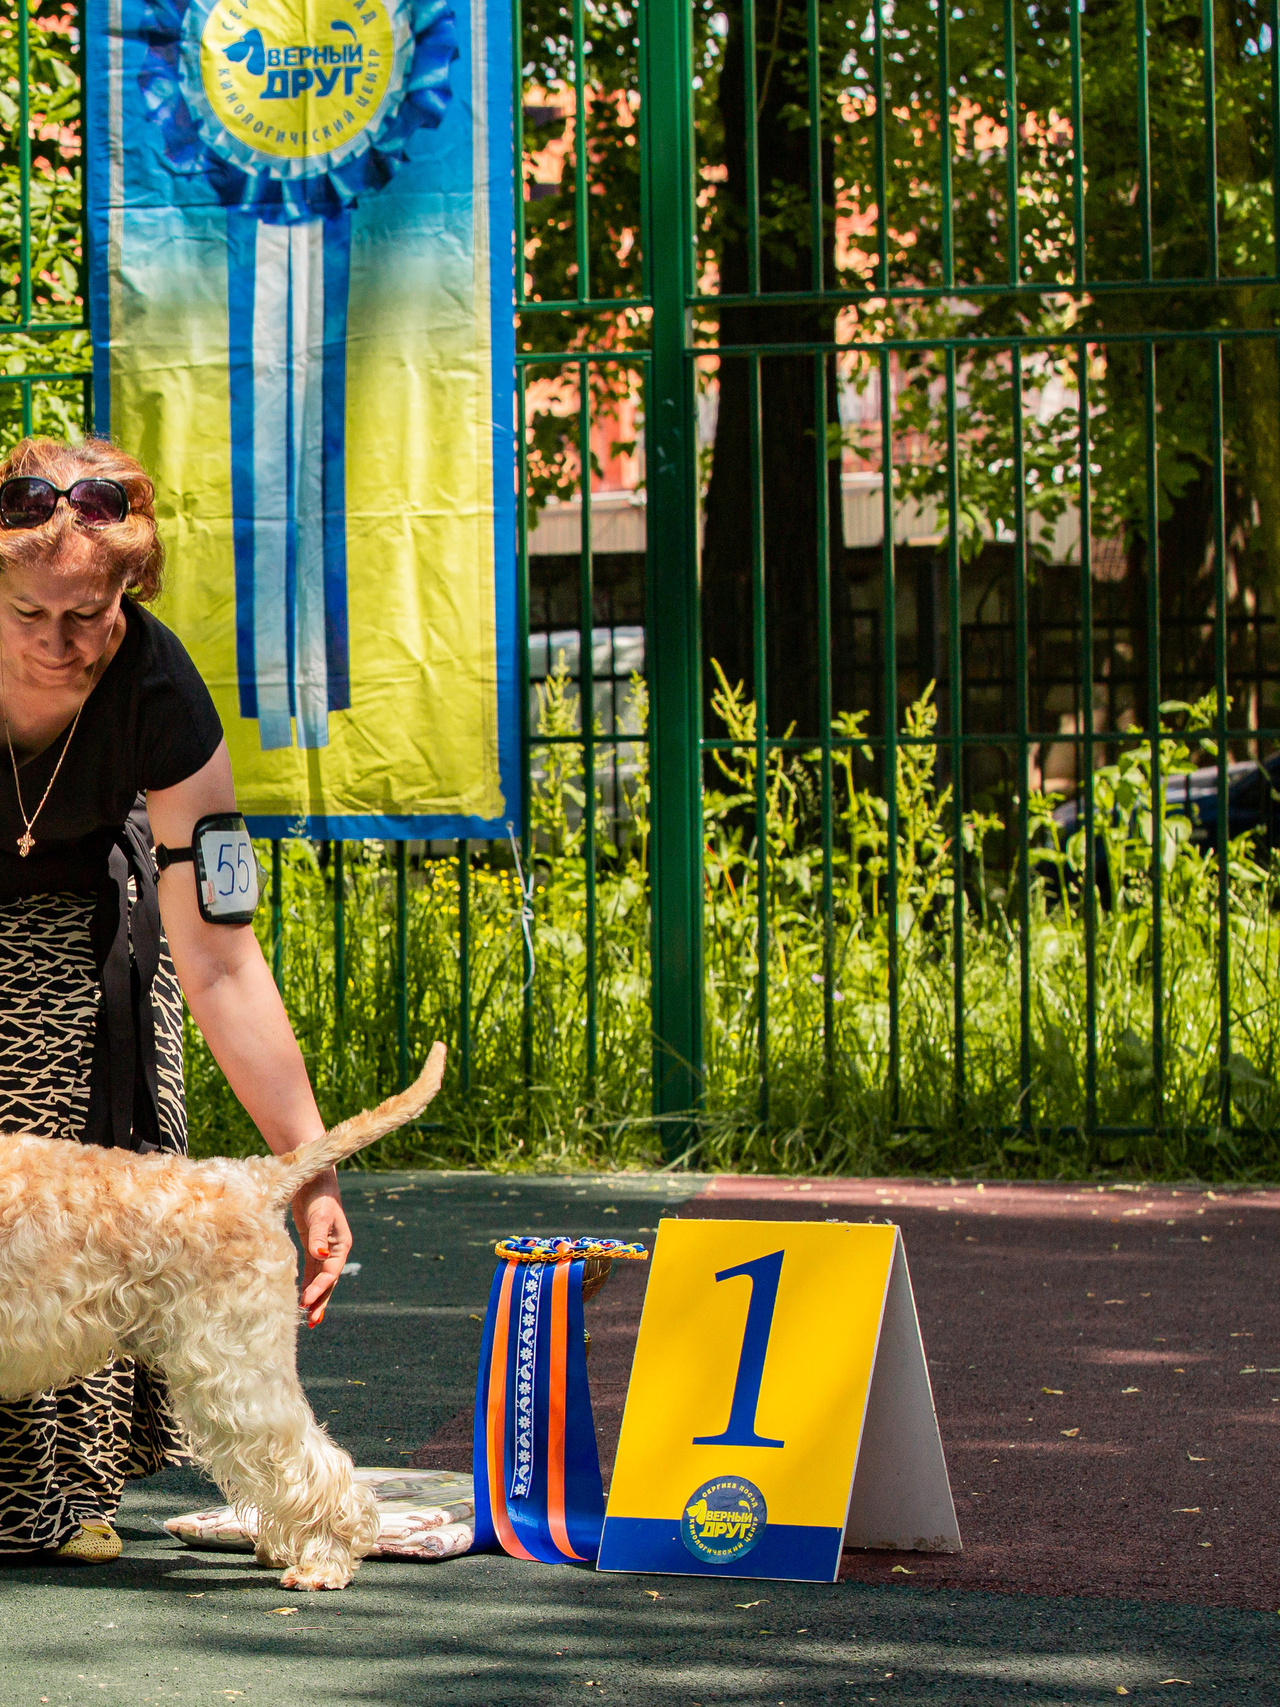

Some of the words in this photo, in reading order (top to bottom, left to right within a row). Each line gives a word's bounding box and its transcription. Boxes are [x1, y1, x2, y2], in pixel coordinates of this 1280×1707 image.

[259, 66, 363, 99] ДРУГ
[355, 48, 381, 108] ЦЕНТР
[216, 842, 250, 896] 55
[691, 1248, 786, 1449] 1
[702, 1483, 737, 1497] СЕРГИЕВ
[739, 1486, 758, 1508] ПОСАД
[699, 1522, 751, 1538] ДРУГ
[744, 1517, 758, 1542] ЦЕНТР
